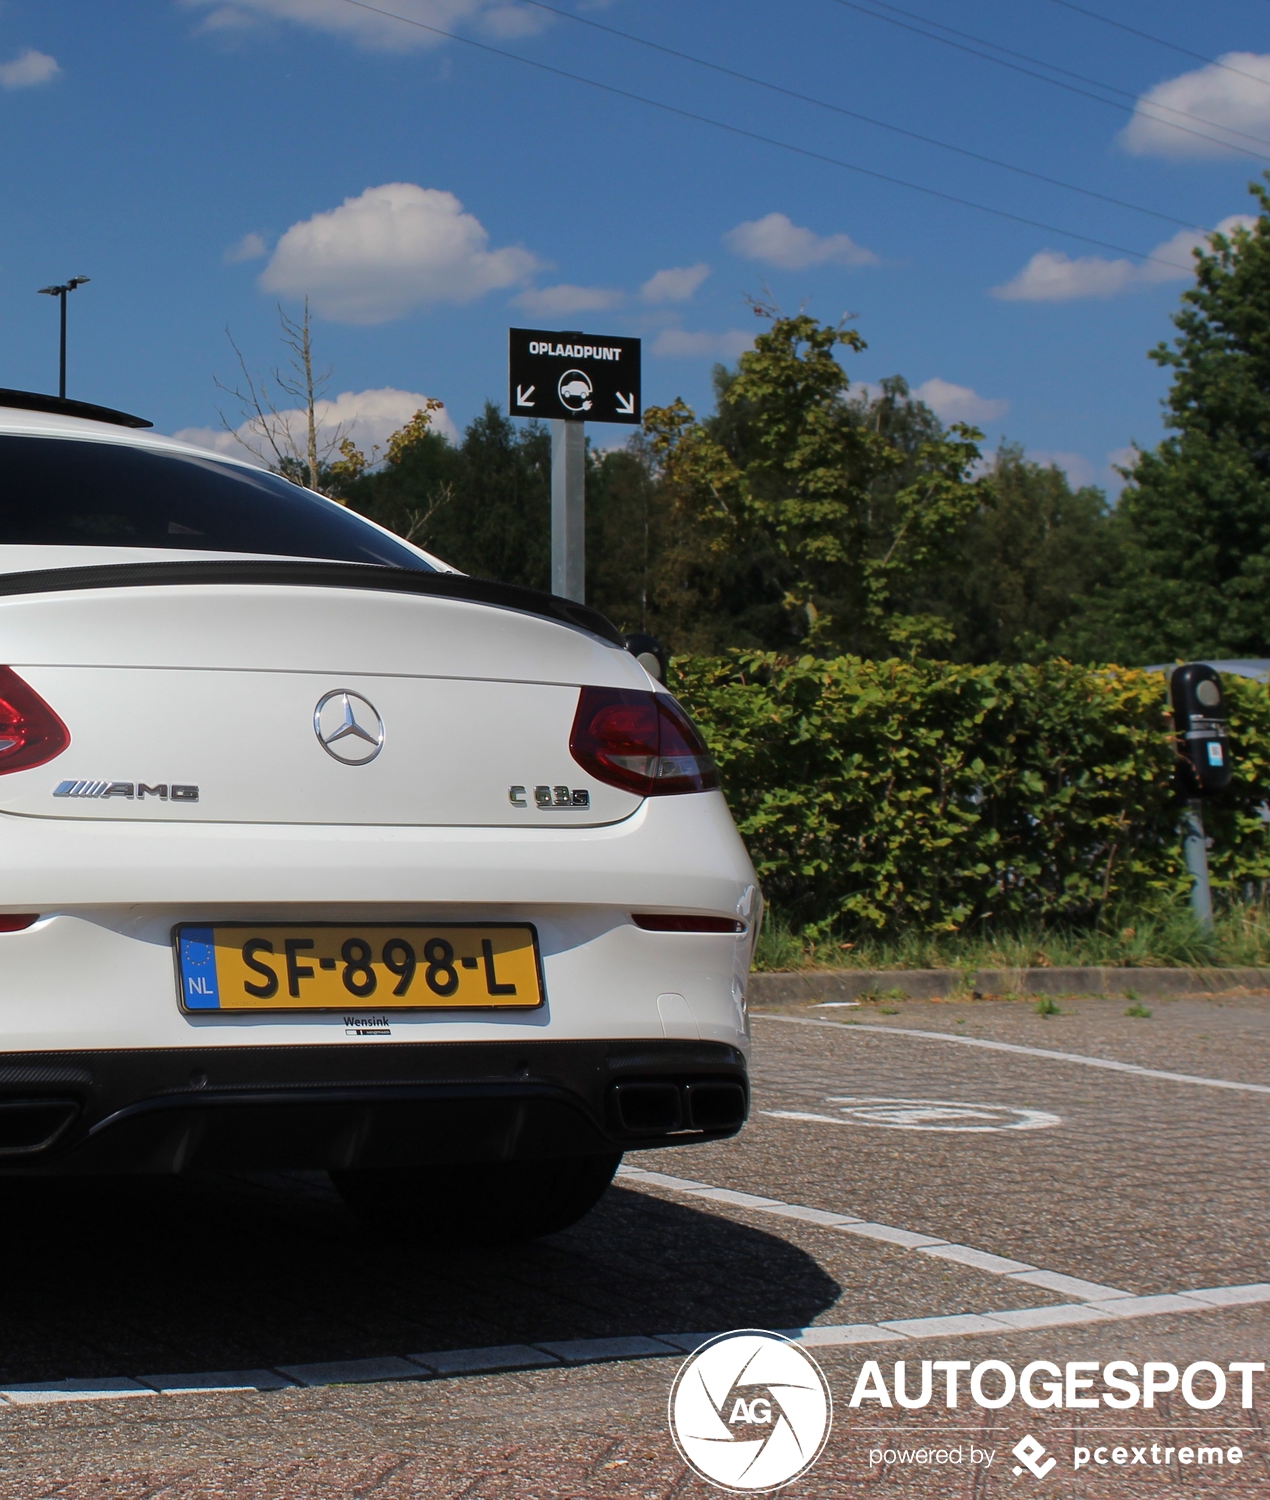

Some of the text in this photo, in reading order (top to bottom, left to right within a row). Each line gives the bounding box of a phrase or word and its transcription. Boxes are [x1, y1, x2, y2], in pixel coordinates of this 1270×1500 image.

[529, 341, 622, 361] OPLAADPUNT
[101, 781, 199, 802] AMG
[241, 937, 517, 998] SF-898-L
[189, 977, 214, 994] NL
[343, 1016, 390, 1027] Wensink
